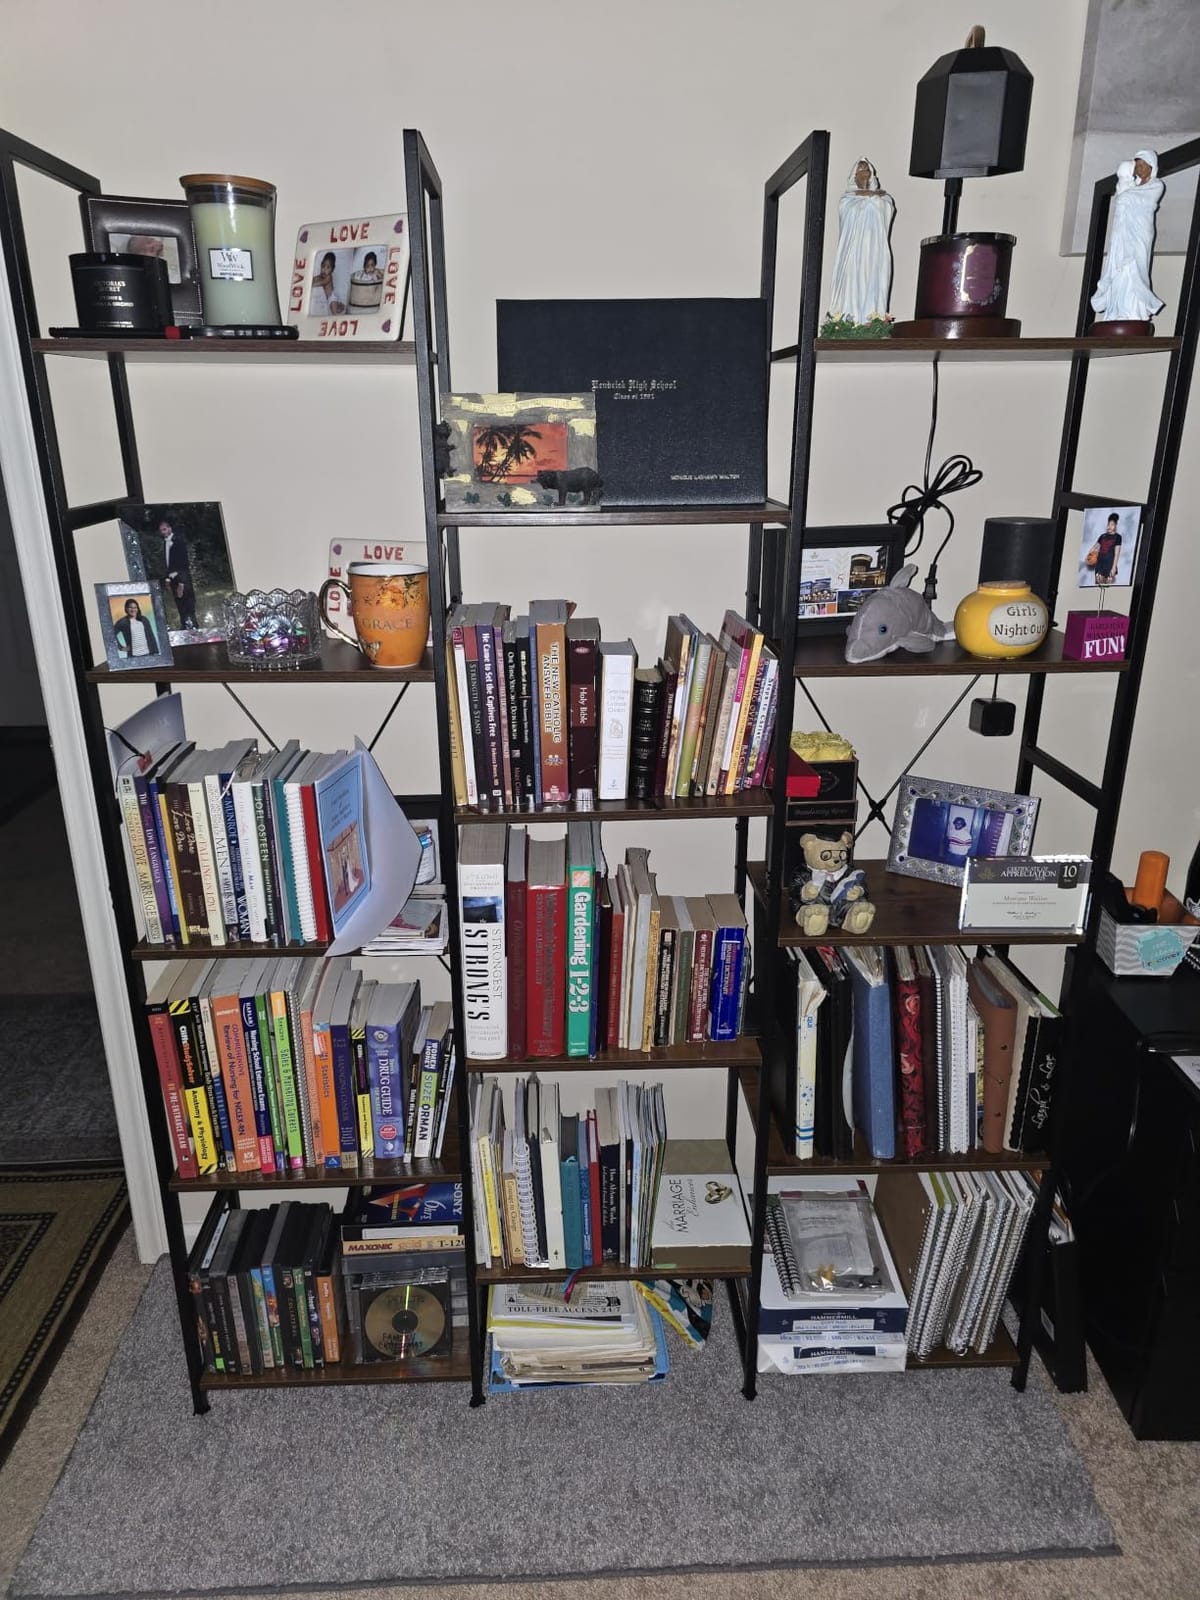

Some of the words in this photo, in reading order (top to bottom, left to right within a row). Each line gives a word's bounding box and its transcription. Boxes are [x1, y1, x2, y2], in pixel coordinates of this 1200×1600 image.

[330, 222, 370, 243] LOVE
[290, 257, 306, 312] LOVE
[383, 246, 401, 305] LOVE
[318, 320, 358, 336] LOVE
[628, 380, 647, 392] High
[650, 380, 677, 391] School
[363, 546, 404, 560] LOVE
[329, 567, 342, 612] LOVE
[361, 617, 414, 630] GRACE
[1006, 606, 1038, 618] Girls
[481, 633, 489, 642] He
[994, 622, 1027, 638] Night
[1030, 624, 1046, 636] Out
[482, 643, 491, 661] Came
[550, 642, 559, 662] THE
[1084, 634, 1126, 658] FUN!
[484, 661, 491, 670] to
[484, 671, 492, 682] Set
[542, 655, 551, 698] ANSWER
[551, 666, 560, 690] NEW
[750, 661, 764, 700] STARTING
[762, 678, 774, 699] Steps
[485, 695, 495, 721] Captives
[577, 687, 587, 705] Holy
[543, 702, 552, 732] BIBLE
[551, 692, 561, 744] CATHOLIC
[578, 707, 587, 724] Bible
[746, 705, 755, 726] OVER
[755, 714, 766, 737] Christ
[488, 723, 496, 736] Free
[139, 792, 147, 804] THE
[254, 798, 264, 819] JOEL
[171, 810, 184, 828] Love
[182, 811, 194, 832] Love
[224, 799, 237, 837] MUNROE
[145, 828, 155, 844] LOVE
[175, 831, 187, 852] Dare
[186, 833, 197, 854] Dare
[257, 824, 270, 861] OSTEEN
[134, 844, 147, 865] LOVE
[214, 836, 227, 867] MEN
[148, 846, 162, 882] LANGUAGES
[1000, 869, 1056, 878] APPRECIATION
[1063, 866, 1077, 878] 10
[198, 841, 210, 876] FALLING
[205, 892, 216, 912] LOVE
[139, 872, 156, 914] MARRIAGE
[236, 895, 251, 934] WOMAN
[570, 891, 591, 964] Gardening
[463, 928, 490, 1020] STRONG'S
[491, 928, 502, 999] STRONGEST
[568, 969, 590, 1013] 1-2-3
[245, 1002, 253, 1023] KAPLAN
[222, 1025, 233, 1050] Review
[231, 1023, 244, 1075] COMPREHENSIVE
[248, 1029, 259, 1050] Nursing
[252, 1052, 261, 1069] School
[279, 1048, 289, 1067] Sales
[423, 1045, 431, 1068] MONEY
[429, 1042, 438, 1068] WOMEN
[226, 1061, 238, 1088] Nursing
[255, 1070, 264, 1092] Entrance
[322, 1066, 331, 1097] Statistics
[378, 1059, 389, 1084] DRUG
[232, 1090, 240, 1098] for
[282, 1075, 293, 1106] Marketing
[380, 1085, 392, 1115] GUIDE
[422, 1075, 432, 1101] SUZE
[257, 1094, 266, 1111] Exams
[169, 1092, 182, 1129] PRE-ENTRANCE
[177, 1132, 187, 1149] EXAM
[190, 1090, 201, 1118] Anatomy
[196, 1126, 209, 1160] Physiology
[233, 1101, 245, 1135] NCLEX-RN
[287, 1108, 296, 1132] Careers
[418, 1103, 430, 1140] ORMAN
[453, 1183, 463, 1215] SONY
[506, 1180, 514, 1202] Courage
[510, 1211, 519, 1231] Change
[669, 1179, 688, 1233] MARRIAGE
[348, 1243, 392, 1252] MAXONIC
